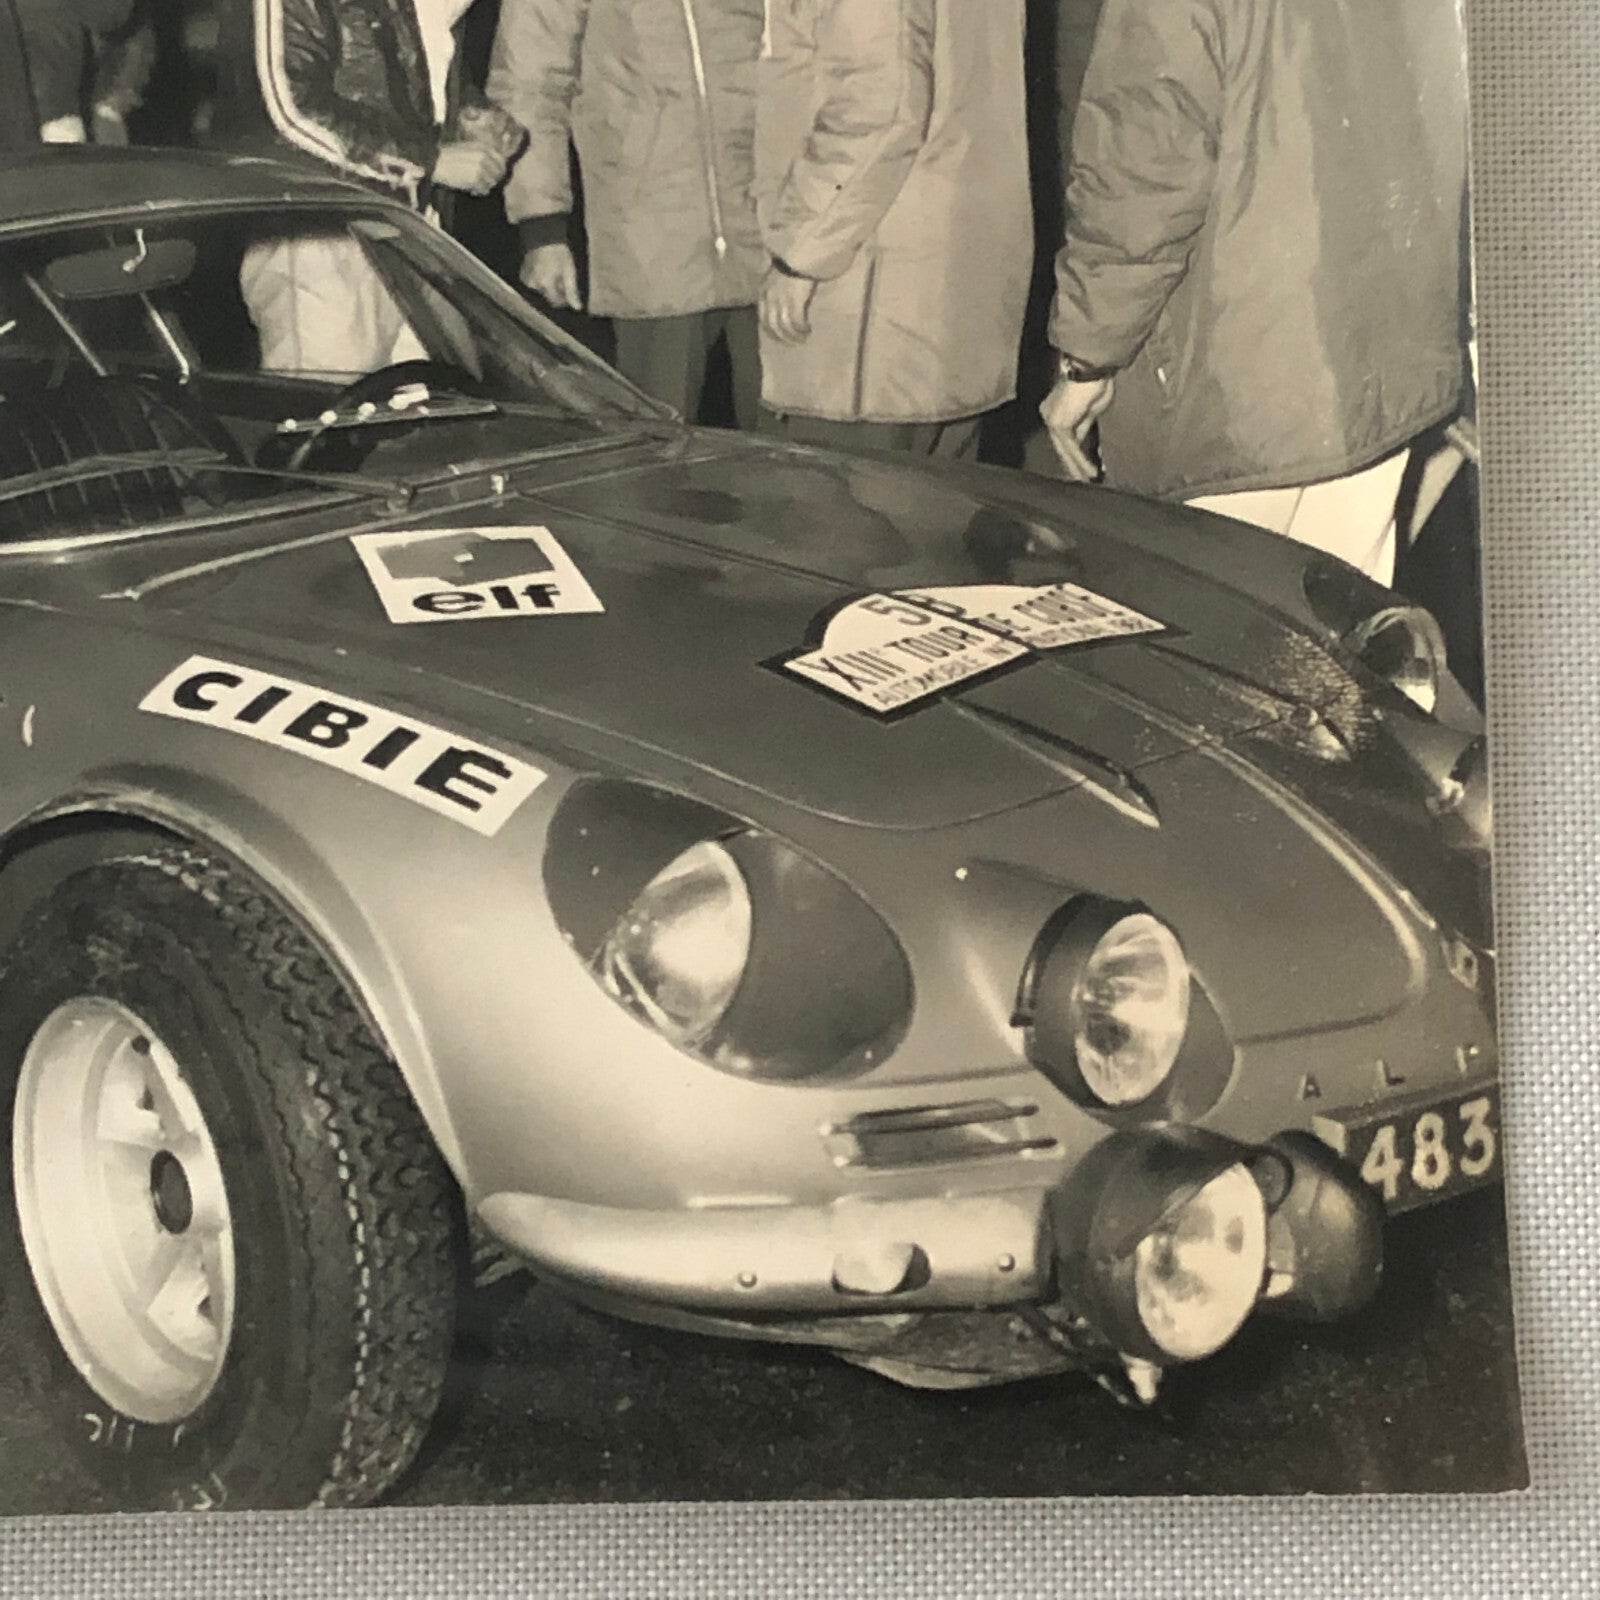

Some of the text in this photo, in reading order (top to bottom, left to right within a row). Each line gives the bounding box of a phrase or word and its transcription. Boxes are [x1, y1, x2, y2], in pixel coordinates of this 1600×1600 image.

[411, 583, 562, 614] elf
[883, 626, 985, 663] TOUR
[1359, 1096, 1496, 1201] 483
